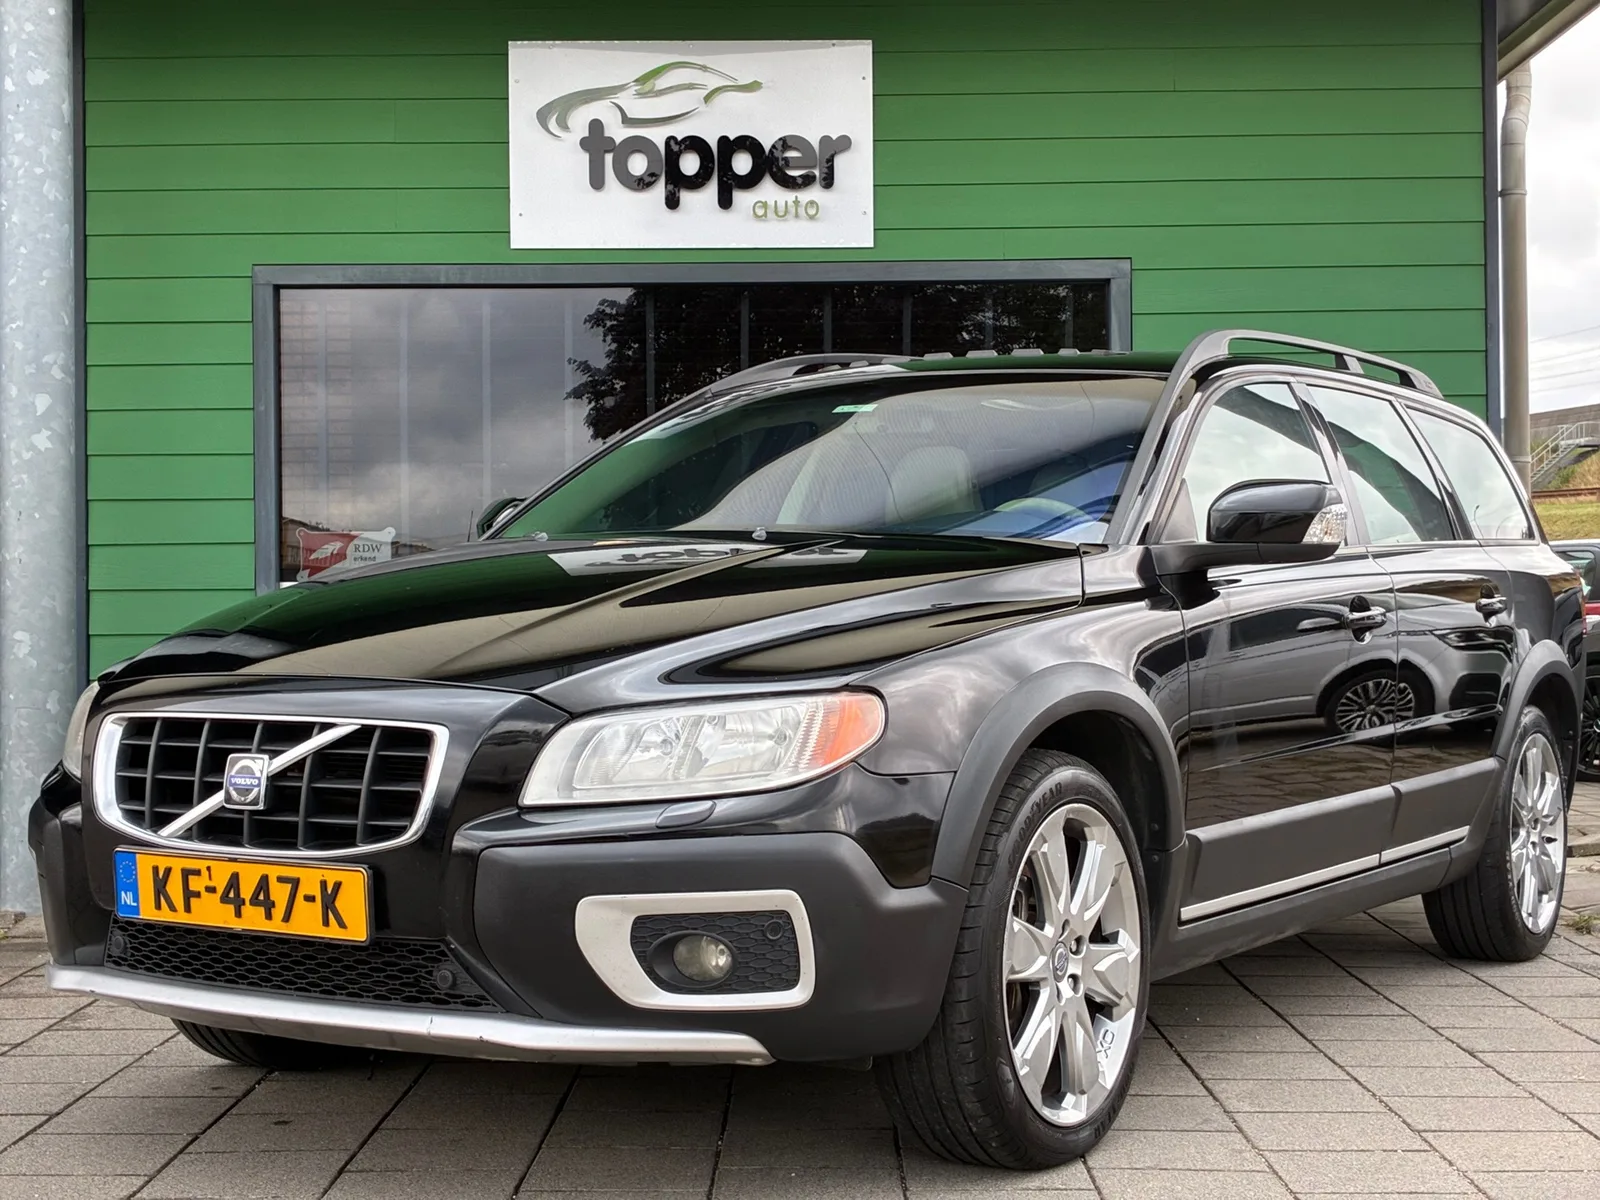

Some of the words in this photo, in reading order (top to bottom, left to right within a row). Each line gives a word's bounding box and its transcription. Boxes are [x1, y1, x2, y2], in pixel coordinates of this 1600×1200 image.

[579, 118, 853, 210] topper
[752, 195, 820, 219] auto
[353, 543, 382, 553] RDW
[231, 777, 259, 786] VOLVO
[120, 891, 137, 906] NL
[151, 864, 348, 929] KF-447-K
